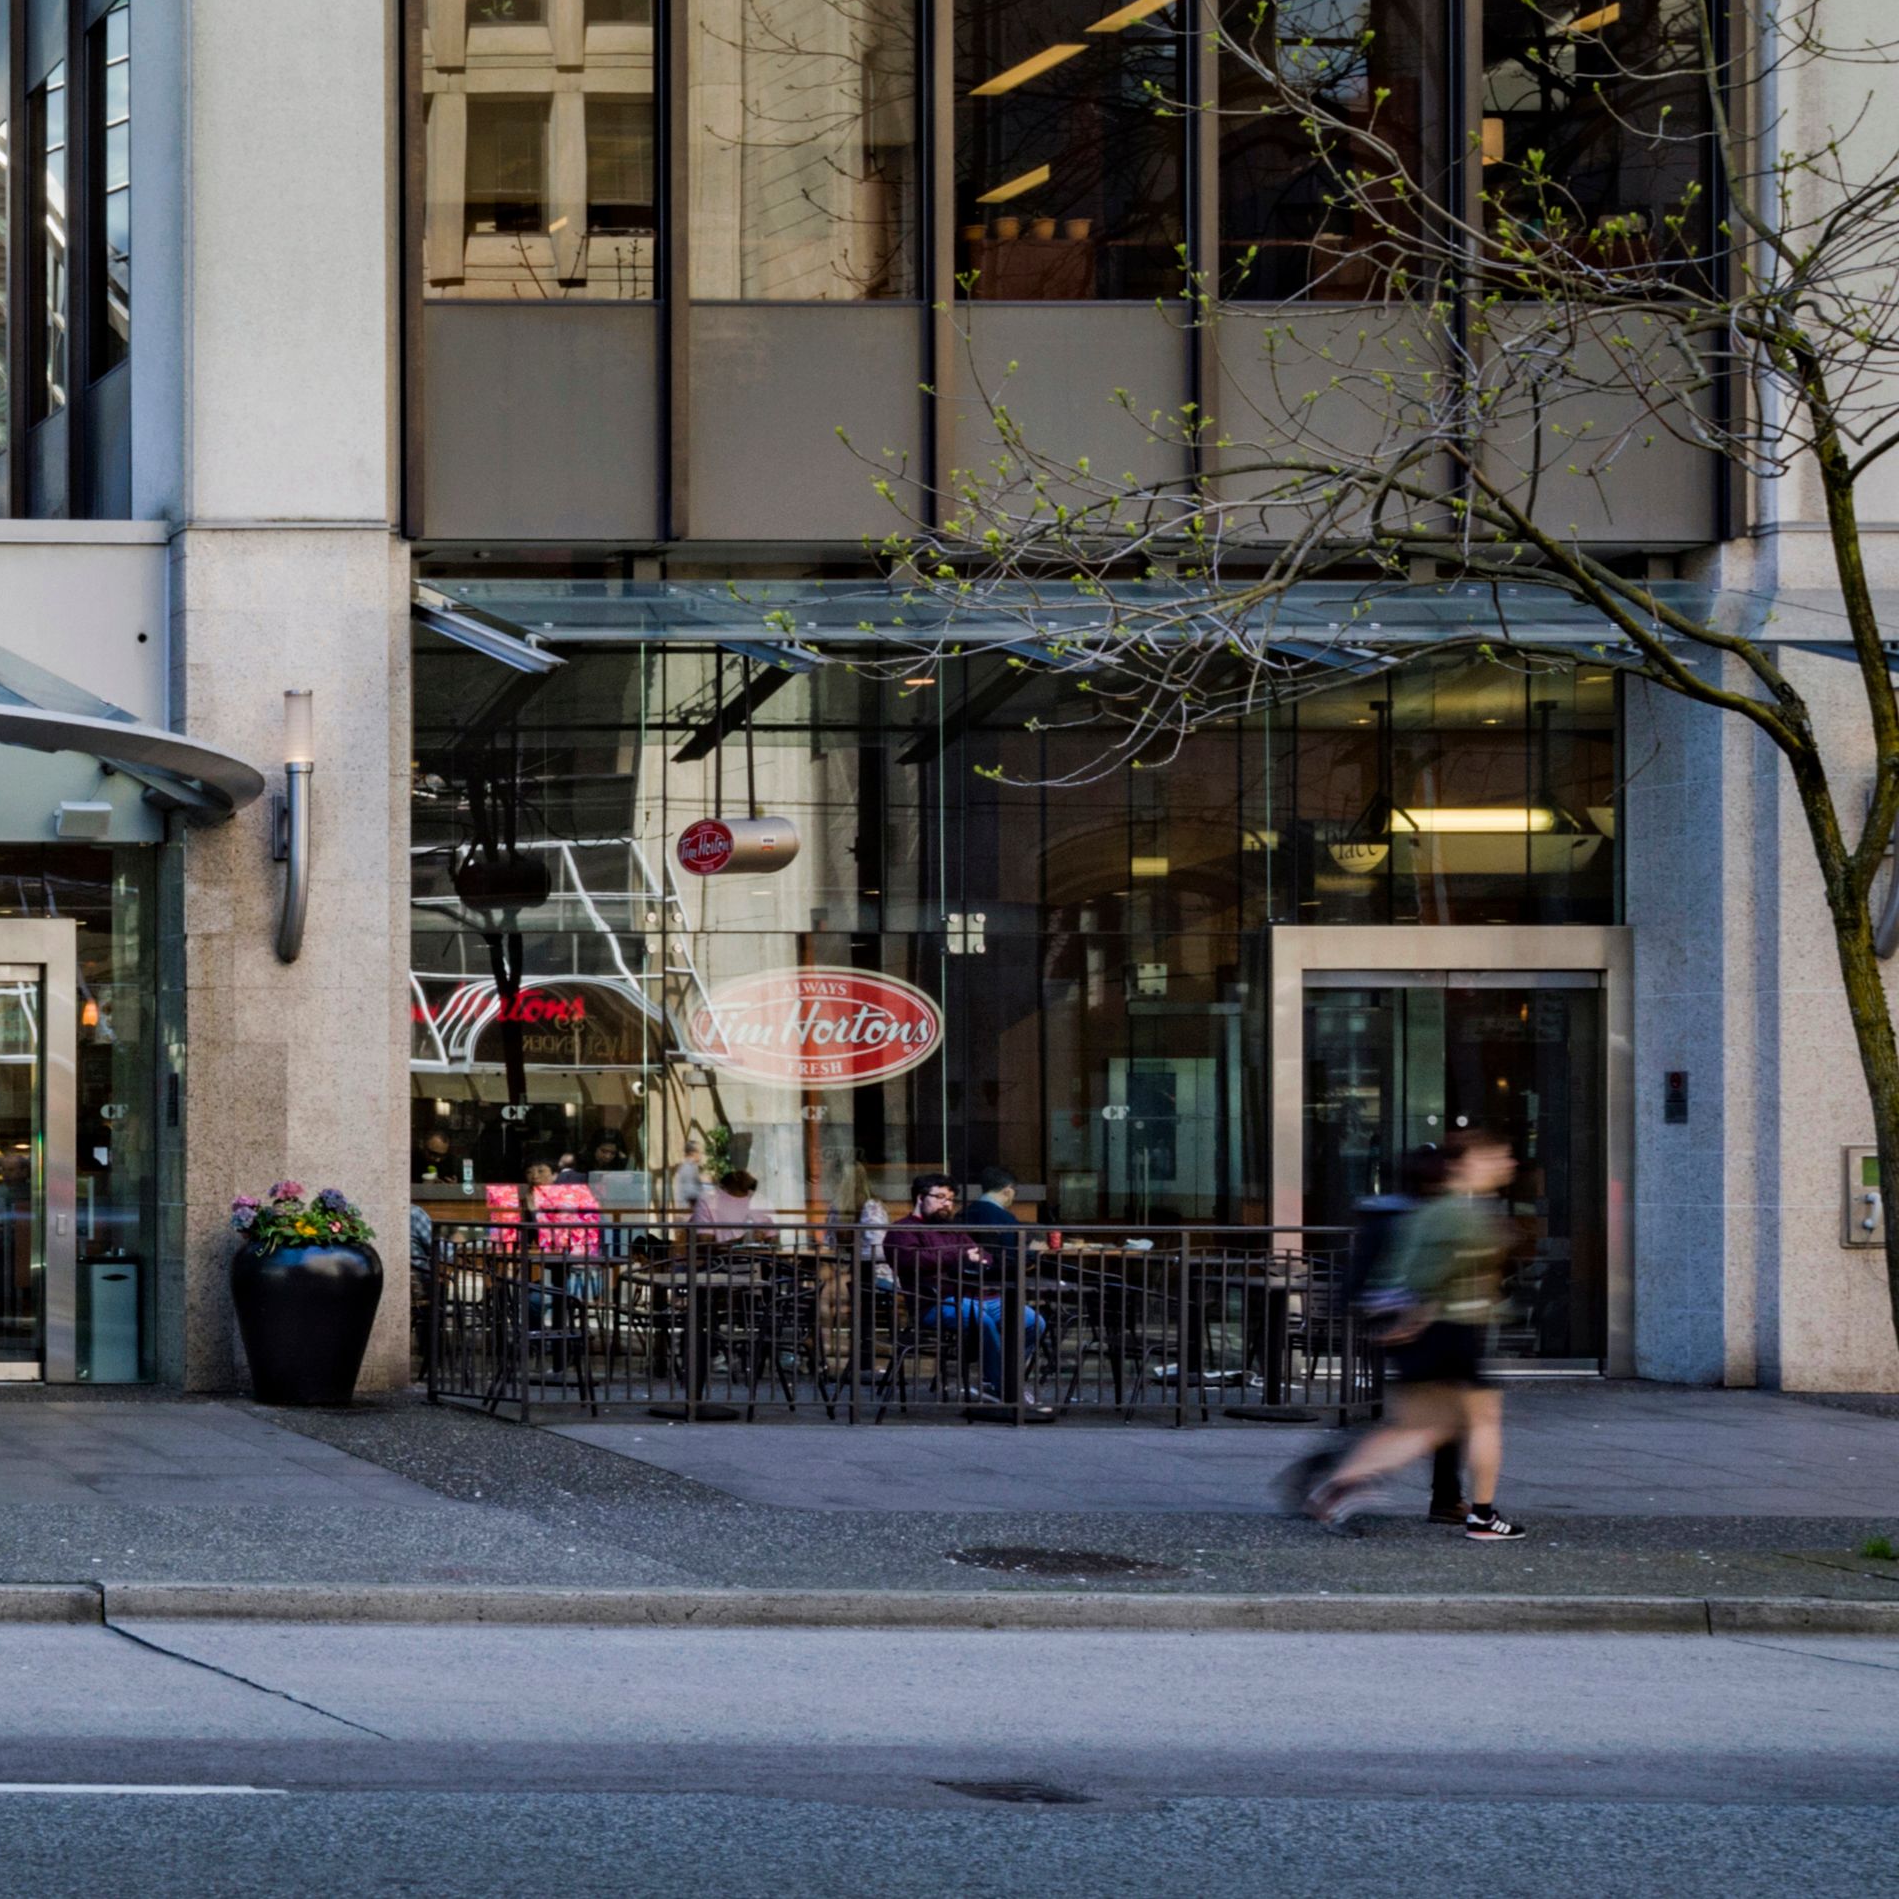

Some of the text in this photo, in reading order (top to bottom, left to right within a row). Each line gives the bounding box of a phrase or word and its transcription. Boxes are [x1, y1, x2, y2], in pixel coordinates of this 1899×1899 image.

[783, 982, 848, 996] ALWAYS
[703, 999, 930, 1047] Tim Hortons
[787, 1061, 843, 1075] FRESH
[100, 1104, 129, 1119] CF
[501, 1105, 529, 1120] CF
[1102, 1105, 1130, 1120] CF
